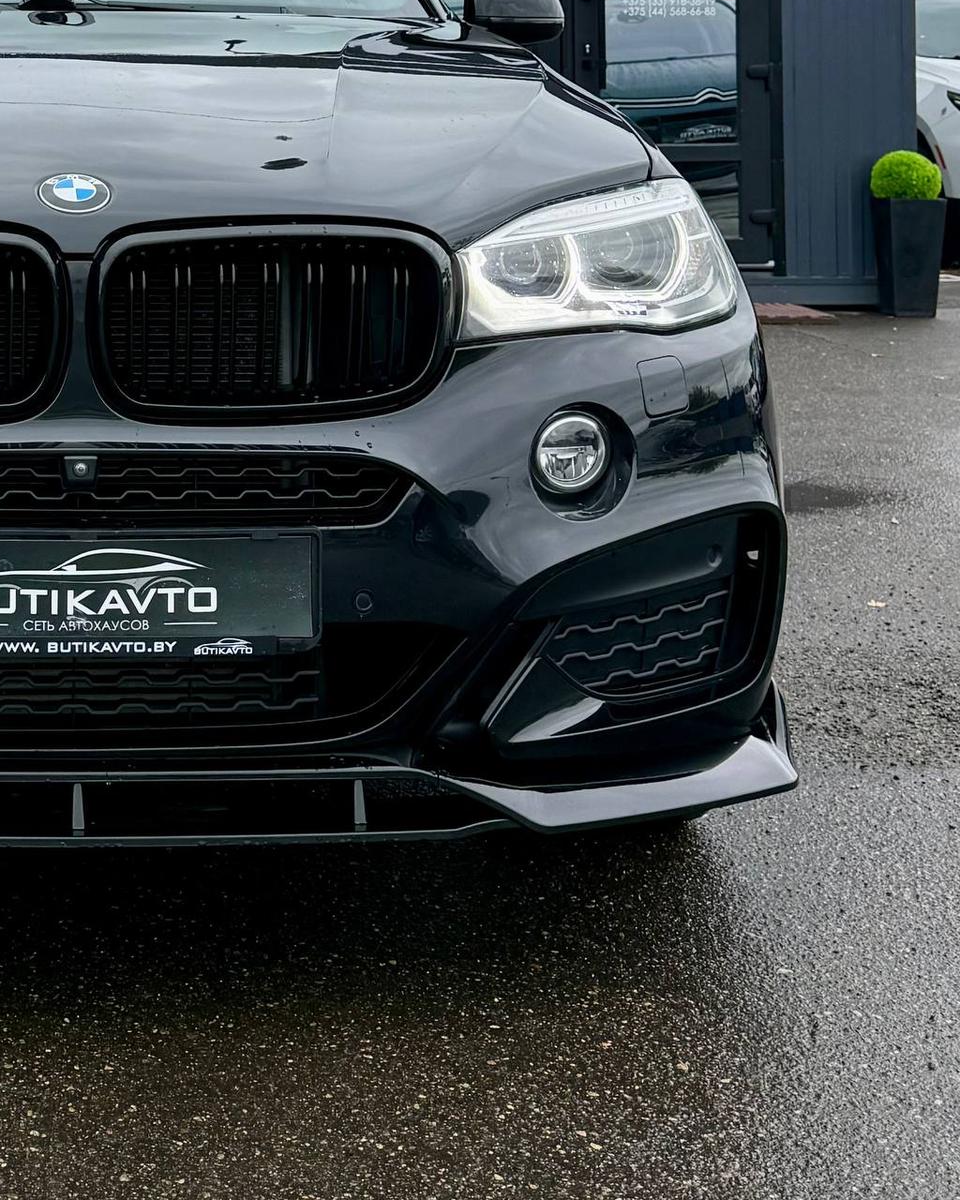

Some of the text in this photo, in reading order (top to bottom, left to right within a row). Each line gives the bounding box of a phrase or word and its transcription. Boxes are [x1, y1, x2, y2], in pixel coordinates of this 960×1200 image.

[623, 7, 716, 18] +375 (44) 568-66-88
[22, 619, 150, 632] СЕТЬ АВТОХАУСОВ
[46, 641, 177, 653] BUTIKAVTO.BY
[193, 646, 253, 656] BUTIKAVTO
